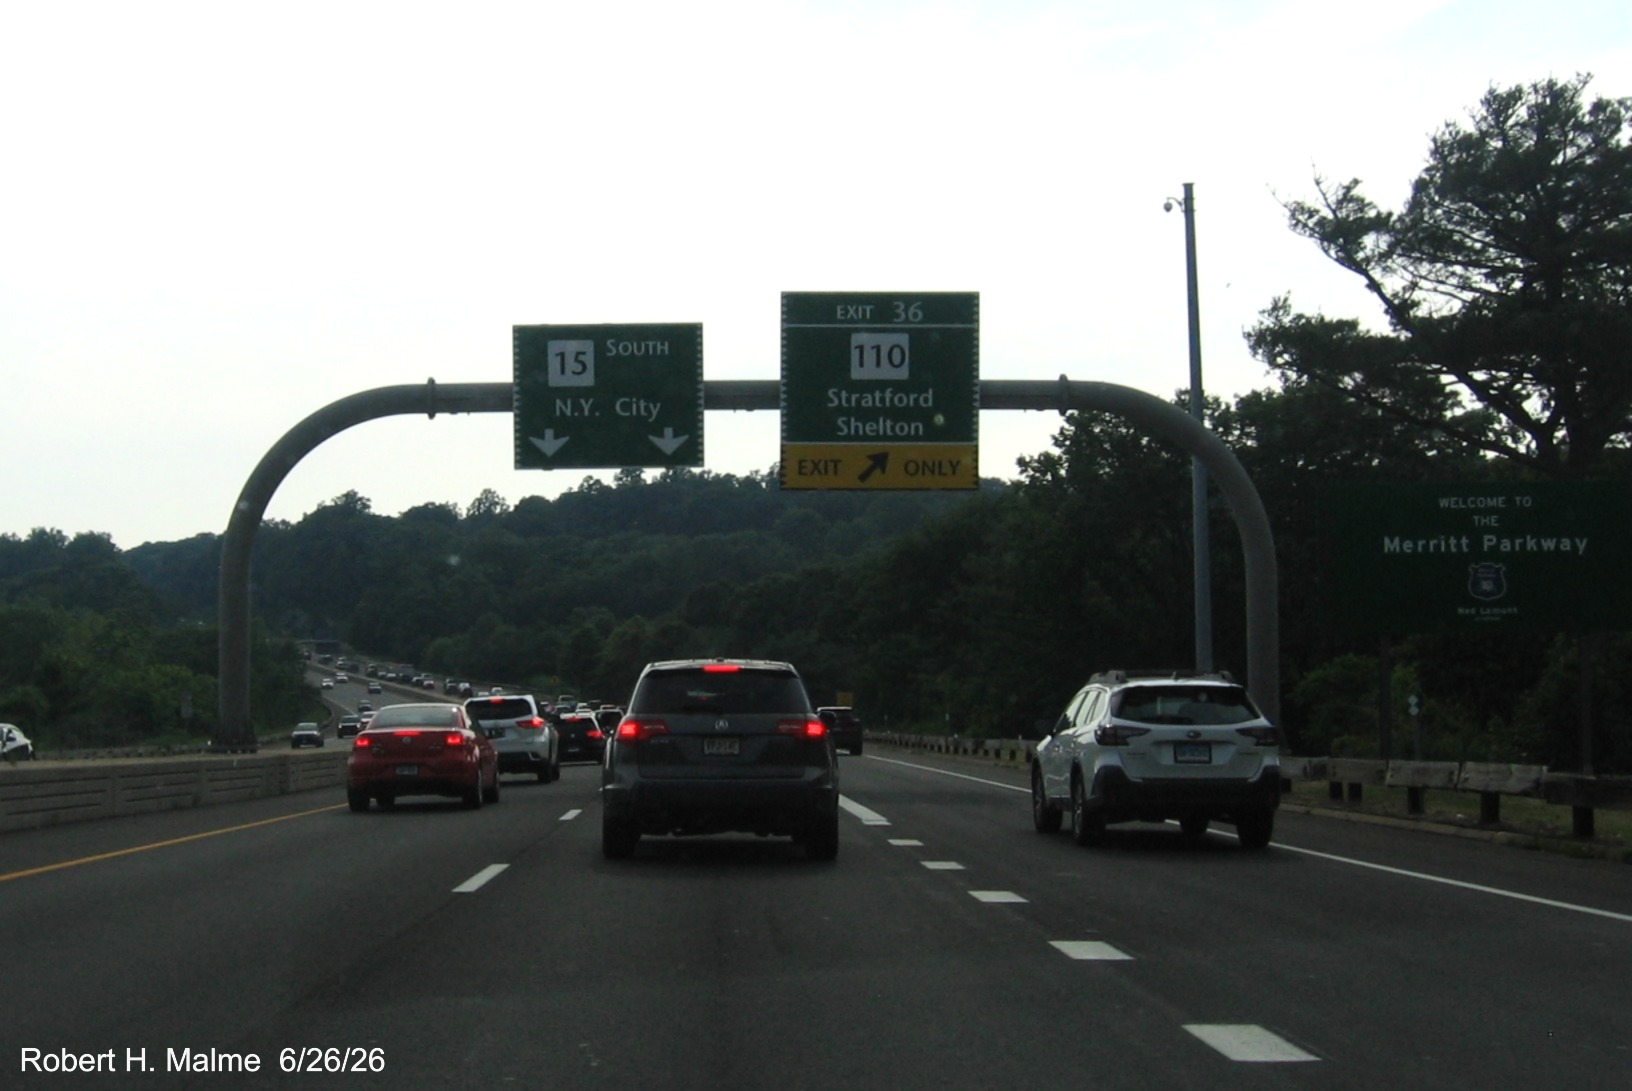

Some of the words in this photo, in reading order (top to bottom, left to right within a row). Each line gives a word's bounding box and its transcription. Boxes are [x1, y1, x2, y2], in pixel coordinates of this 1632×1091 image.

[836, 304, 874, 320] EXIT
[892, 301, 924, 323] 36
[606, 338, 670, 357] SOUTH
[853, 343, 907, 369] 110
[554, 350, 588, 377] 15
[555, 398, 601, 417] N.Y.
[615, 397, 662, 421] City
[826, 387, 934, 409] Stratford
[836, 416, 925, 437] Shelton
[797, 459, 843, 477] EXIT
[904, 459, 962, 477] ONLY
[1438, 496, 1506, 509] WELCOME
[1515, 496, 1533, 508] TO
[1472, 515, 1500, 527] THE
[1383, 535, 1470, 554] Merritt
[1483, 534, 1589, 556] Parkway
